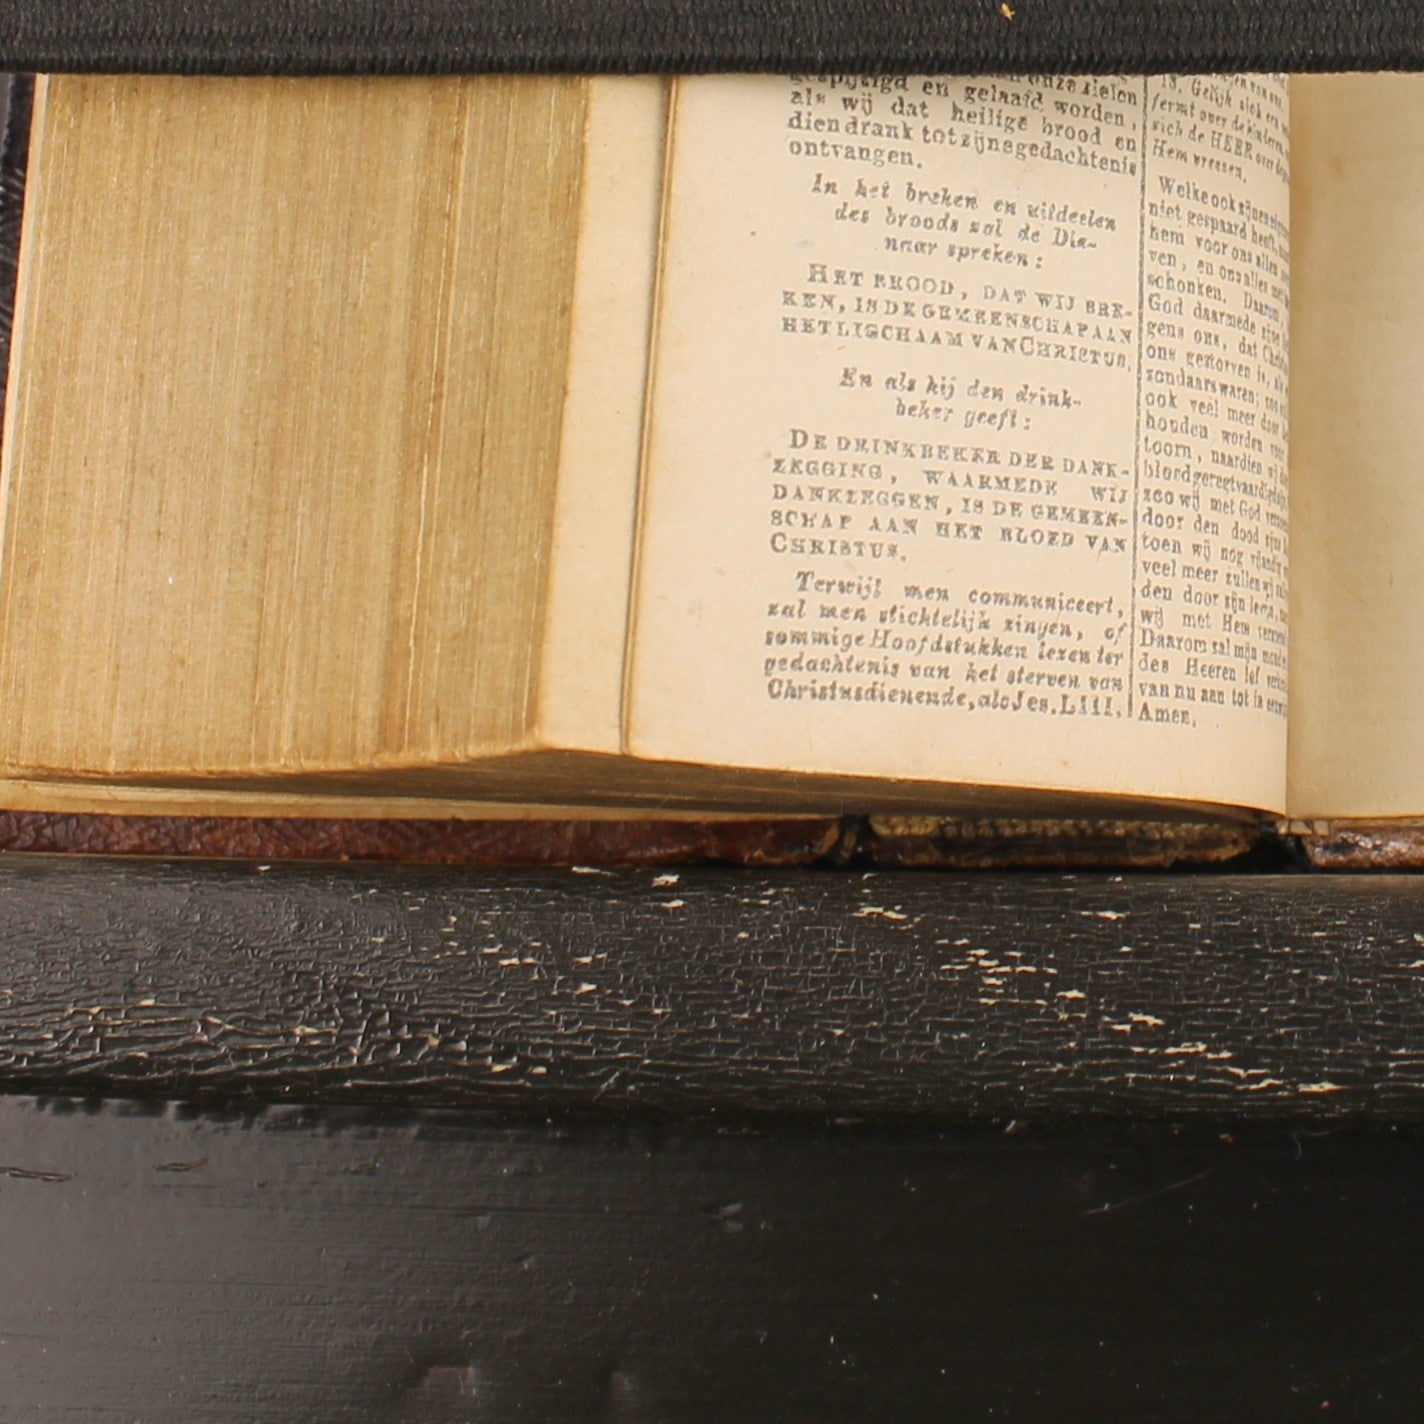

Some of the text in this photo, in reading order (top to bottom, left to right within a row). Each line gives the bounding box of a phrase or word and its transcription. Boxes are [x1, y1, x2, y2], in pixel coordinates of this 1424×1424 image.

[840, 86, 873, 115] wij
[889, 95, 929, 117] dat
[1040, 116, 1101, 144] brood
[1113, 135, 1137, 151] en
[788, 140, 923, 168] ontvangen.
[1149, 292, 1183, 316] God
[966, 378, 1004, 401] den
[1142, 531, 1182, 554] toen
[903, 584, 950, 601] men
[967, 590, 1125, 617] communiceert,
[763, 651, 900, 676] gedachtenis
[908, 663, 950, 679] van
[964, 661, 998, 682] het
[1087, 675, 1124, 691] van
[1138, 652, 1237, 682] des Heeren
[1138, 702, 1197, 727] Amen.
